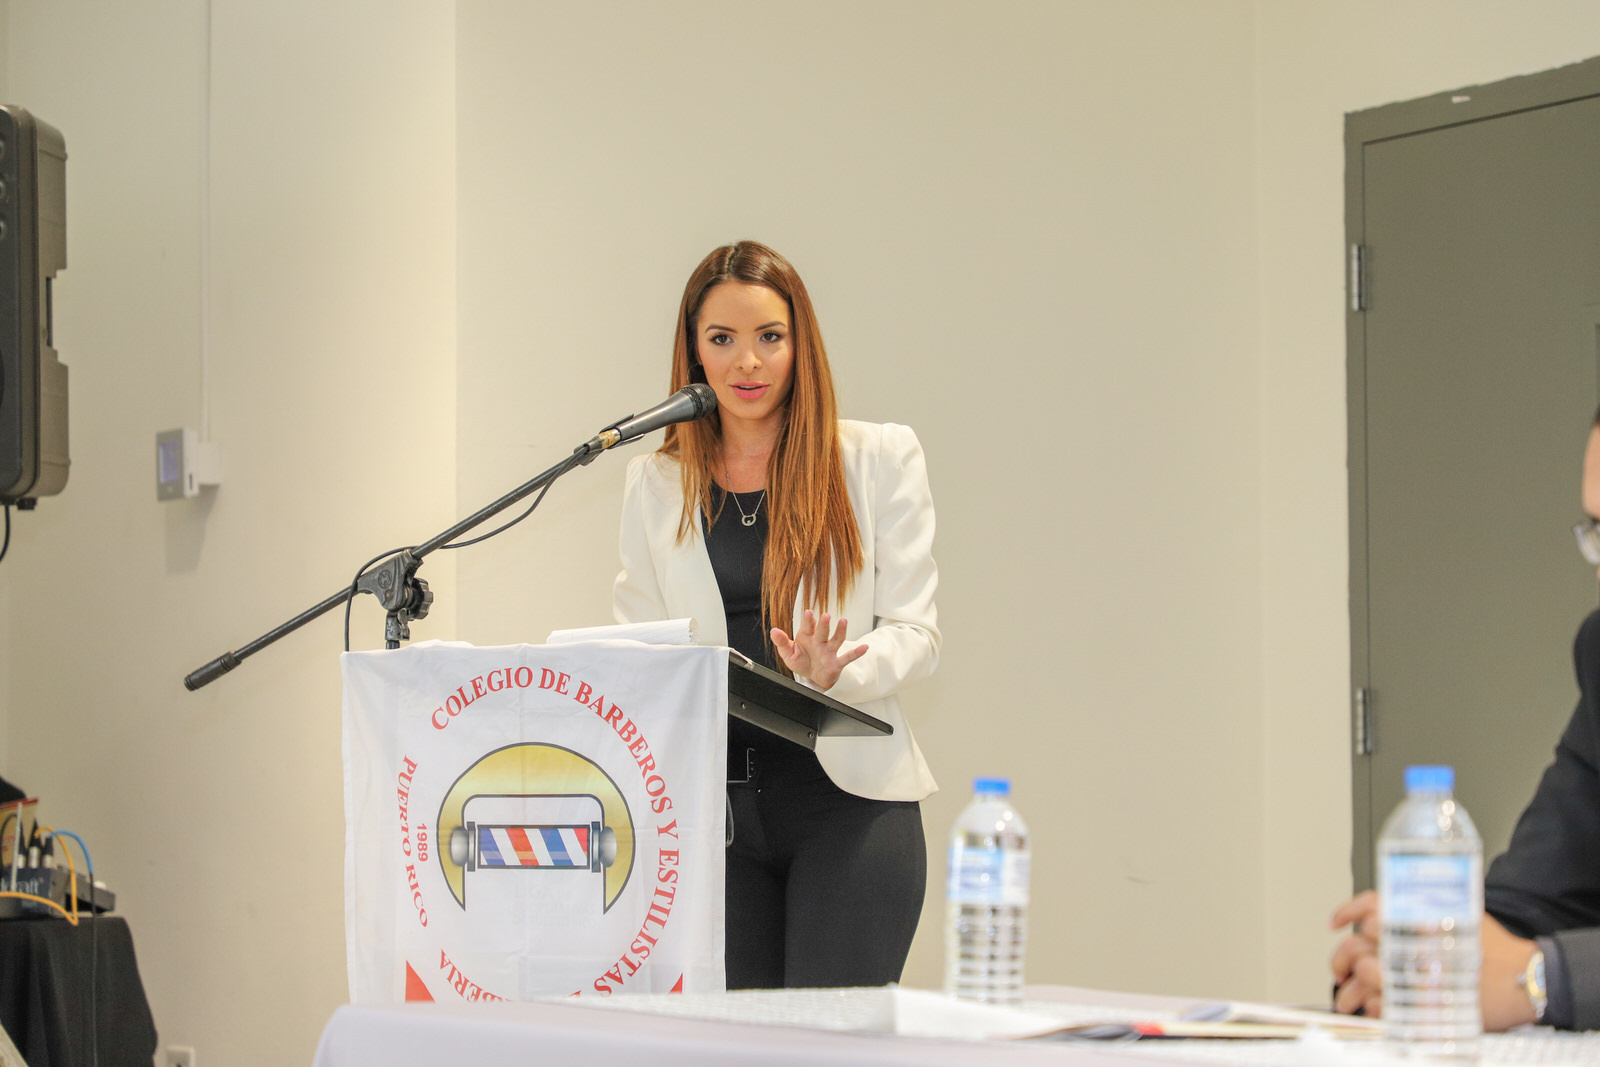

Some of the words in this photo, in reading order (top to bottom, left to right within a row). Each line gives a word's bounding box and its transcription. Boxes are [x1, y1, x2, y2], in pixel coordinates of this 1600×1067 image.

[431, 666, 534, 731] COLEGIO
[537, 667, 572, 696] DE
[572, 679, 674, 815] BARBEROS
[396, 755, 418, 858] PUERTO
[656, 818, 680, 841] Y
[416, 823, 429, 863] 1989
[405, 863, 429, 928] RICO
[593, 846, 681, 998] ESTILISTAS
